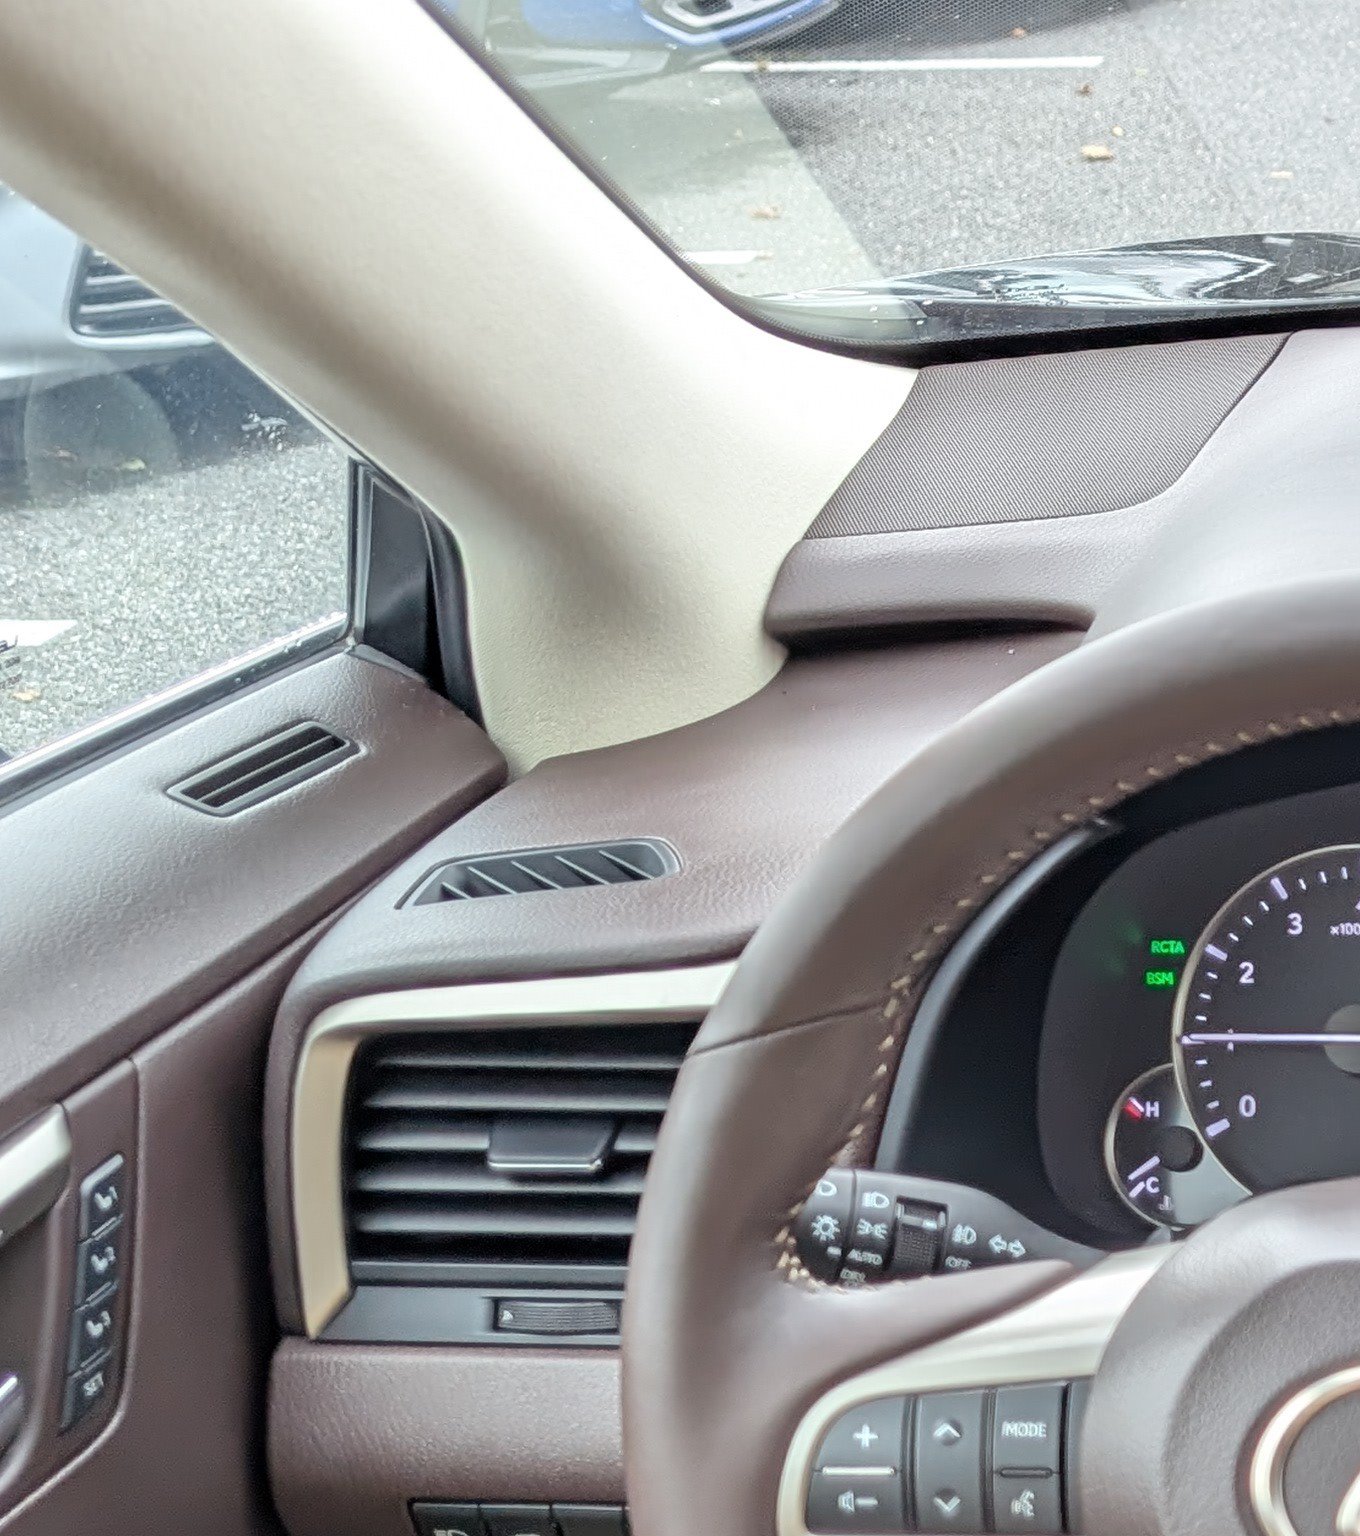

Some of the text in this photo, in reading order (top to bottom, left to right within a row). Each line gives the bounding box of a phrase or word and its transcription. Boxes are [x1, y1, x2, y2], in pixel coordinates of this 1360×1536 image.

[1287, 912, 1303, 936] 3
[1150, 939, 1186, 955] RCTA
[1145, 970, 1174, 986] BSM
[1238, 961, 1256, 985] 2
[1145, 1101, 1160, 1118] H
[1238, 1095, 1257, 1118] 0
[1146, 1177, 1160, 1195] C
[1001, 1420, 1047, 1439] MODE
